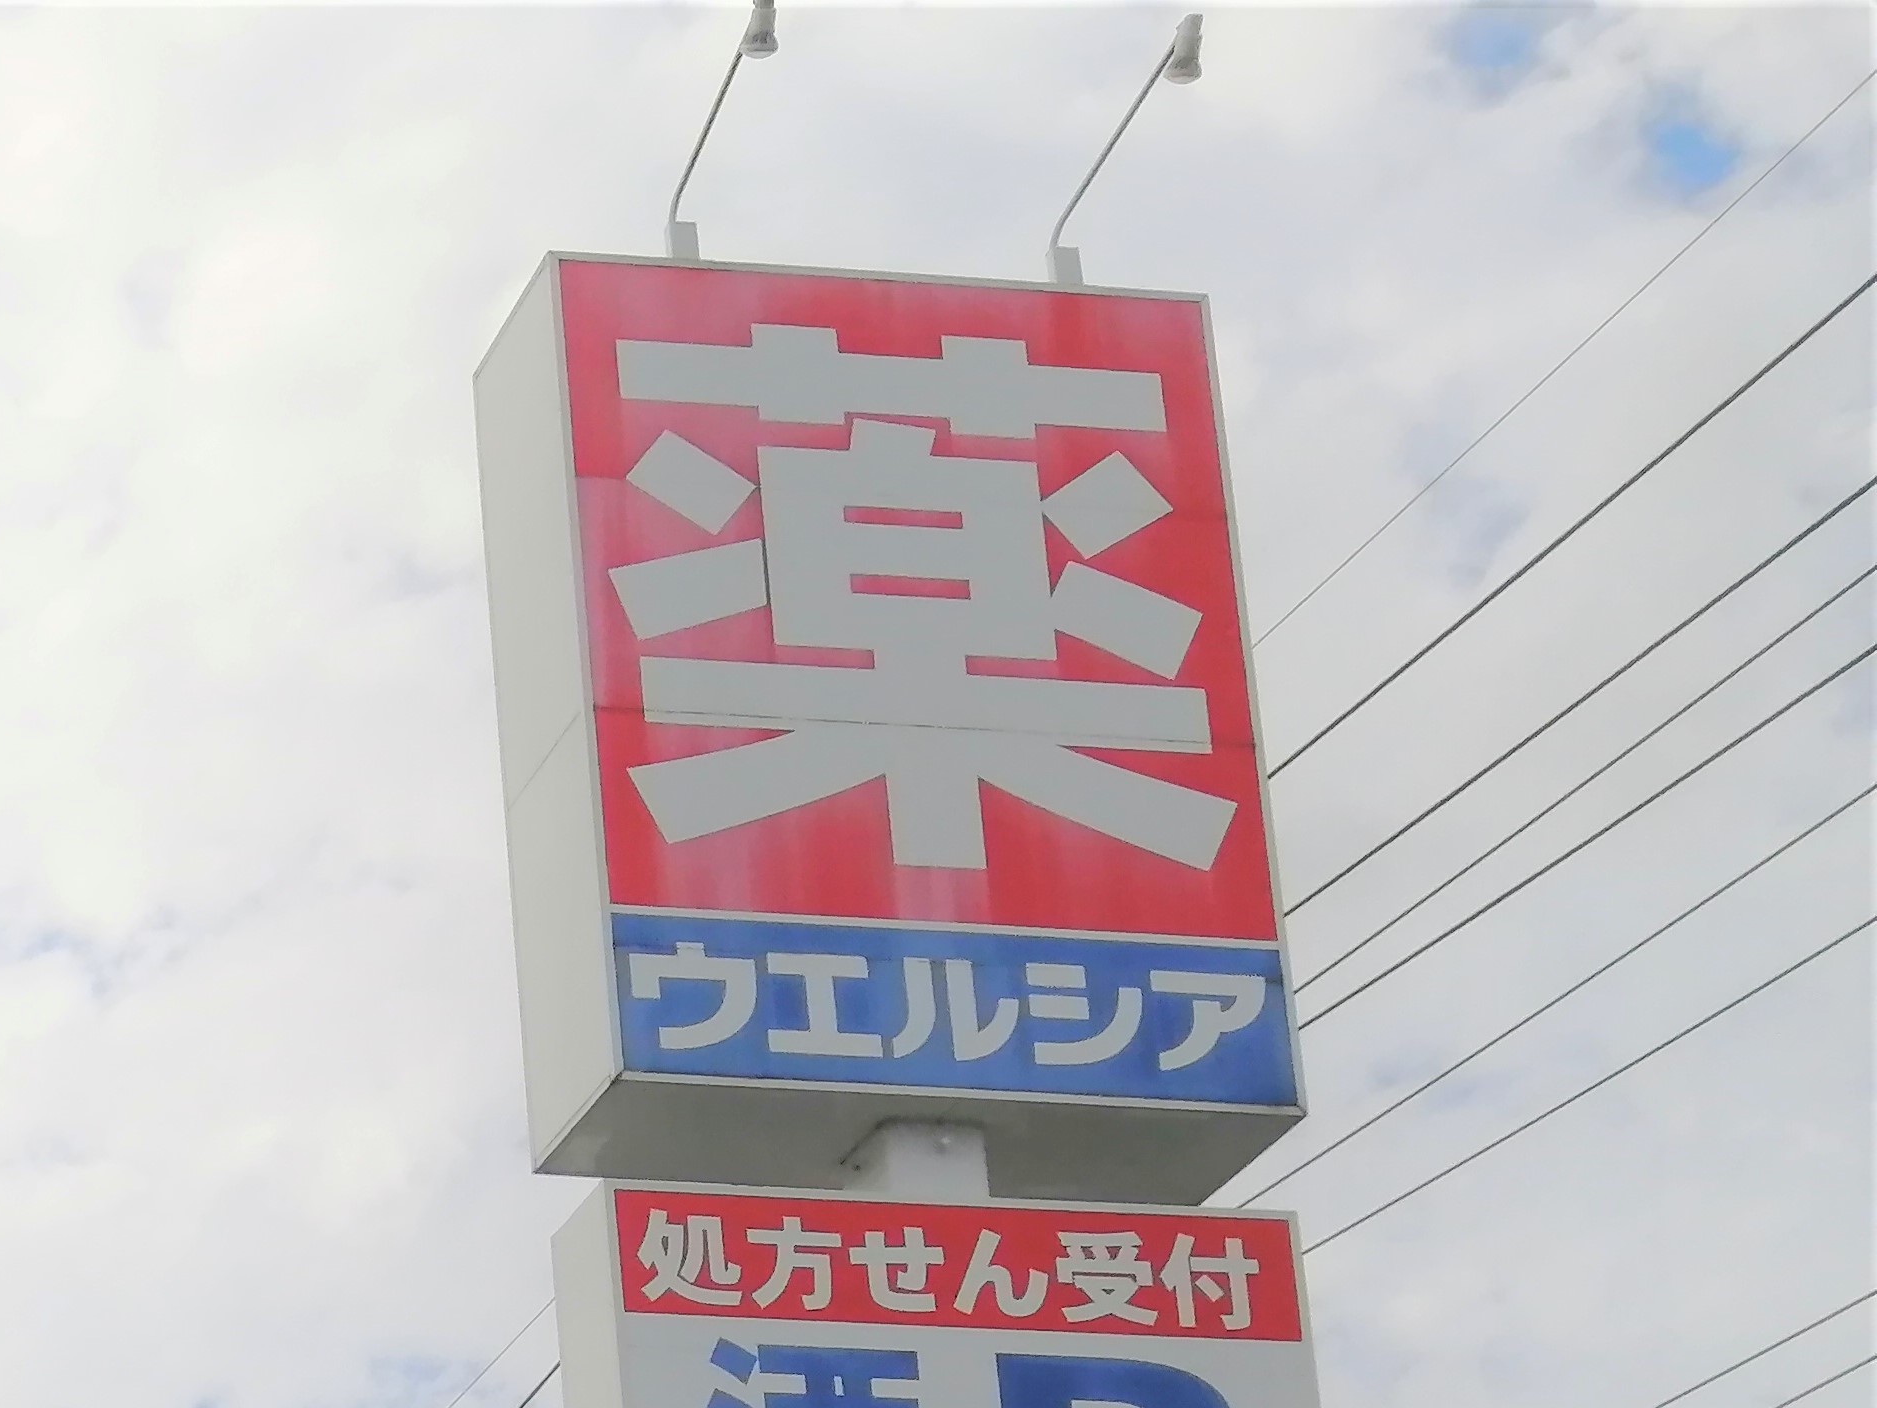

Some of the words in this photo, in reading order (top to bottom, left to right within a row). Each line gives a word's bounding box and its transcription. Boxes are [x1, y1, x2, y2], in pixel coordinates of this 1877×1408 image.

[607, 323, 1238, 871] 薬
[629, 942, 1265, 1070] ウエルシア
[637, 1209, 1259, 1332] 処方せん受付
